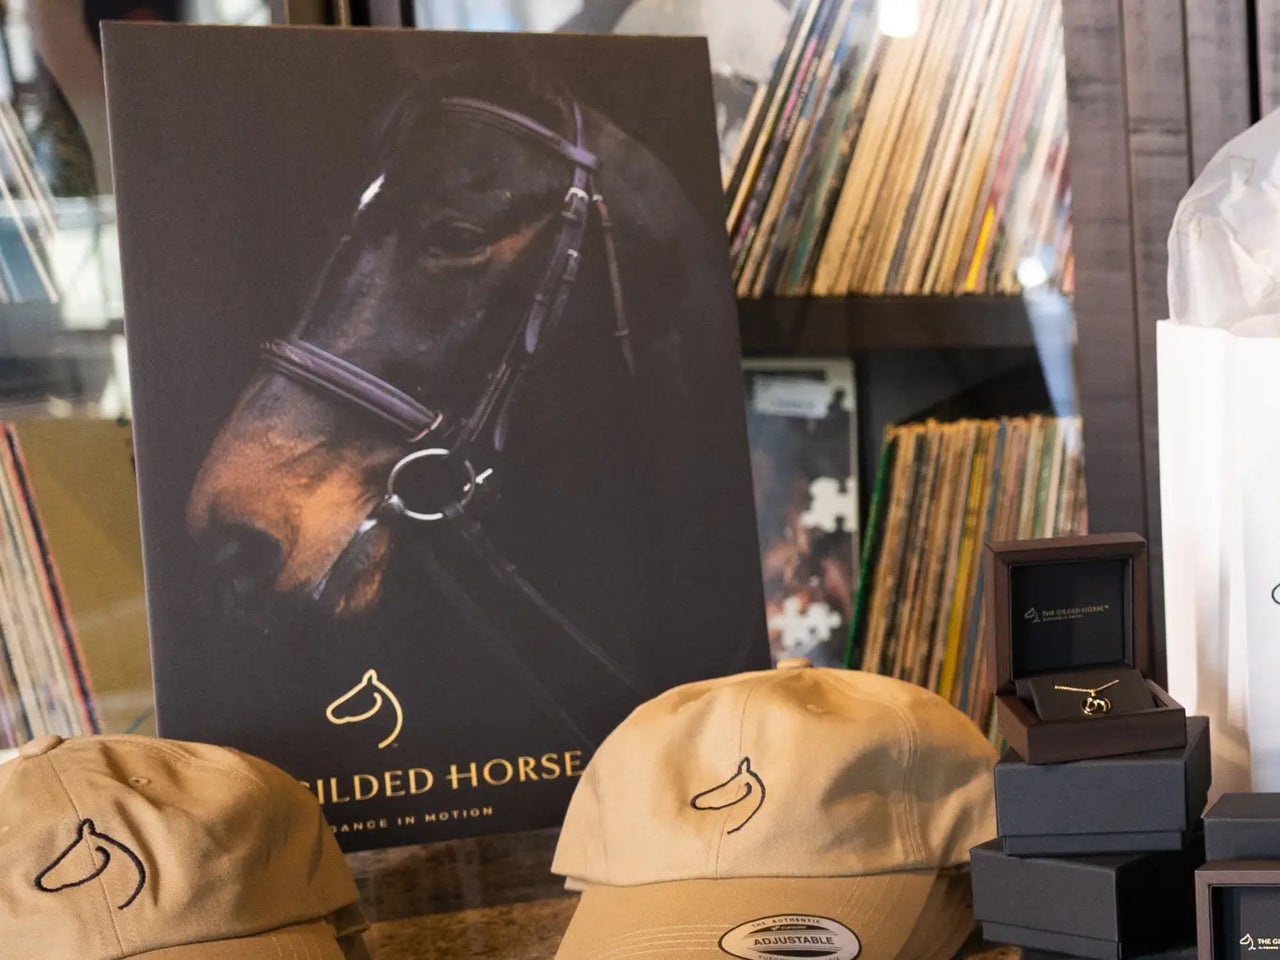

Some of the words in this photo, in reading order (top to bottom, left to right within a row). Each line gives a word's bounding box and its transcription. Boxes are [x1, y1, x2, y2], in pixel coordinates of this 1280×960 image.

[300, 767, 434, 804] ILDED
[446, 750, 585, 789] HORSE
[398, 815, 415, 827] IN
[425, 805, 494, 823] MOTION
[754, 936, 835, 946] ADJUSTABLE
